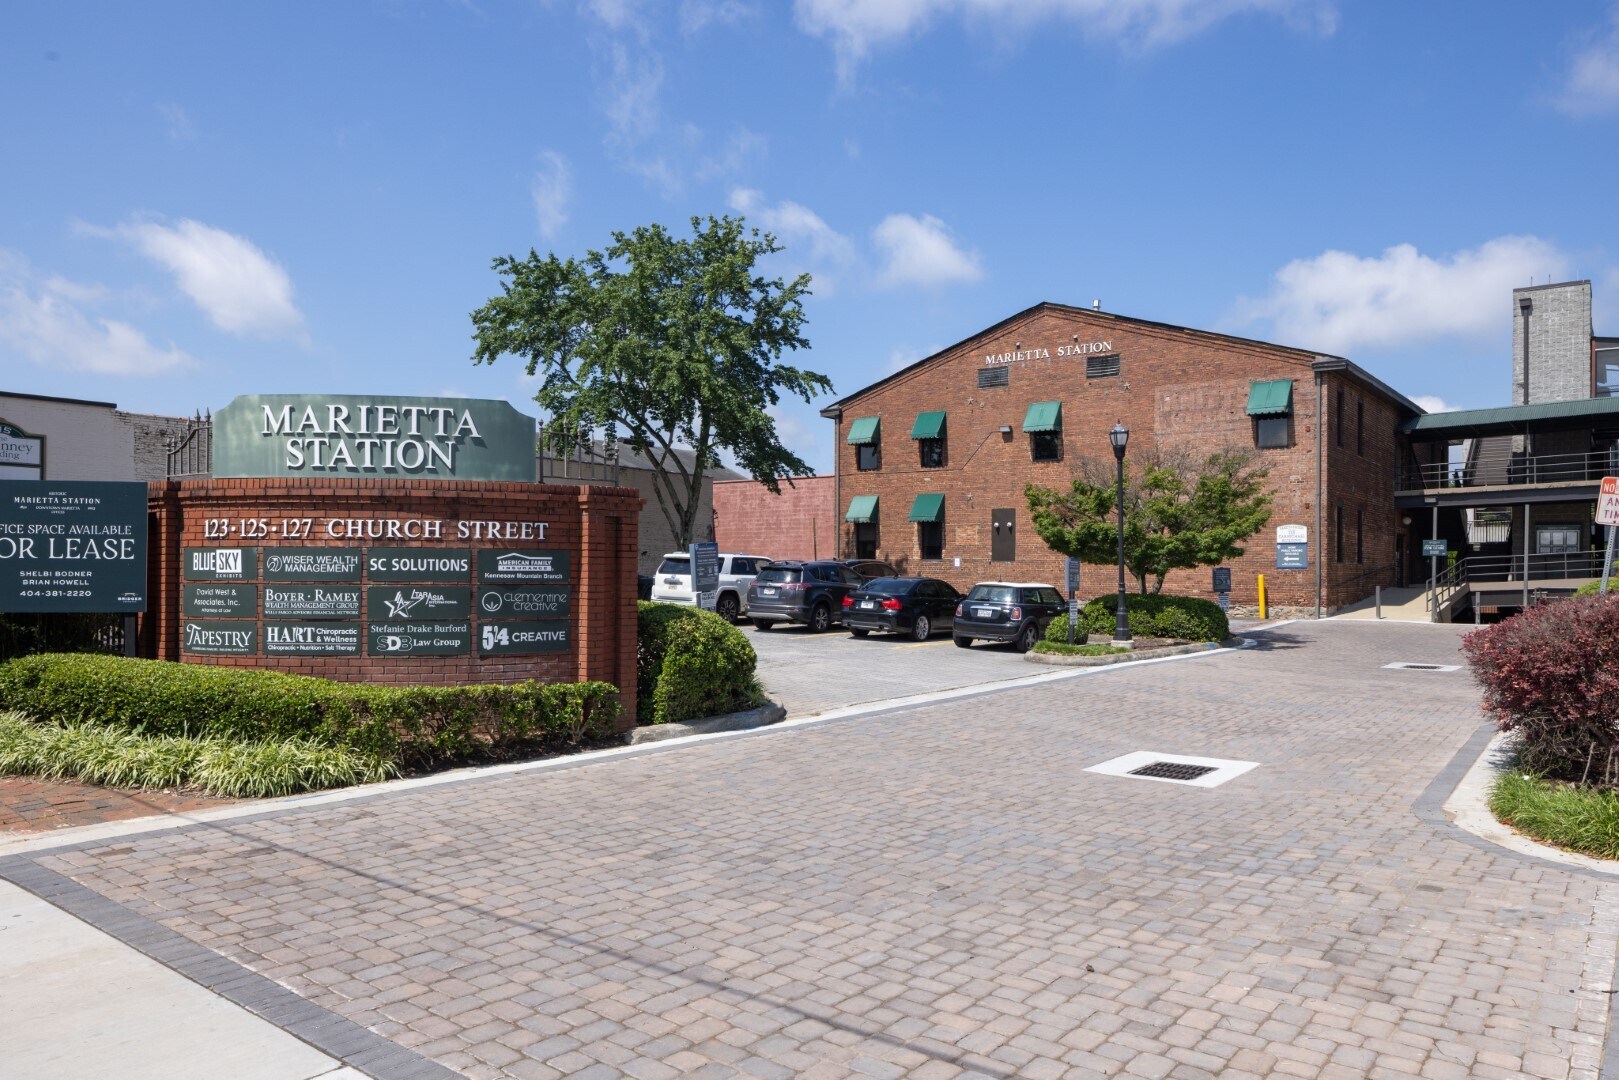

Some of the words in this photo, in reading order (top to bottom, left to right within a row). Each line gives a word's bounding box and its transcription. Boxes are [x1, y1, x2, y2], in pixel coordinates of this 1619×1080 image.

[985, 348, 1050, 365] MARIETTA
[1057, 341, 1112, 356] STATION
[261, 404, 482, 438] MARIETTA
[286, 438, 456, 470] STATION
[1603, 482, 1615, 493] NO
[14, 496, 59, 504] MARIETTA
[27, 524, 65, 535] SPACE
[68, 525, 132, 535] AVAILABLE
[327, 519, 442, 538] CHURCH
[457, 520, 549, 540] STREET
[0, 537, 38, 559] OR
[49, 538, 135, 560] LEASE
[193, 552, 216, 571] BLUE
[219, 552, 239, 570] SKY
[282, 556, 314, 564] WISER
[316, 556, 358, 564] WEALTH
[370, 558, 387, 571] SC
[392, 558, 469, 572] SOLUTIONS
[285, 564, 356, 573] MANAGEMENT
[266, 588, 305, 601] BOYER
[315, 589, 359, 602] RAMEY
[186, 623, 252, 647] TAPESTRY
[266, 625, 315, 643] HART
[316, 628, 358, 636] Chiropractic
[370, 625, 405, 633] Stefanie
[407, 625, 432, 633] Drake
[434, 625, 467, 633] Burford
[413, 639, 431, 647] Law
[433, 639, 461, 648] Group
[511, 631, 566, 642] CREATIVE
